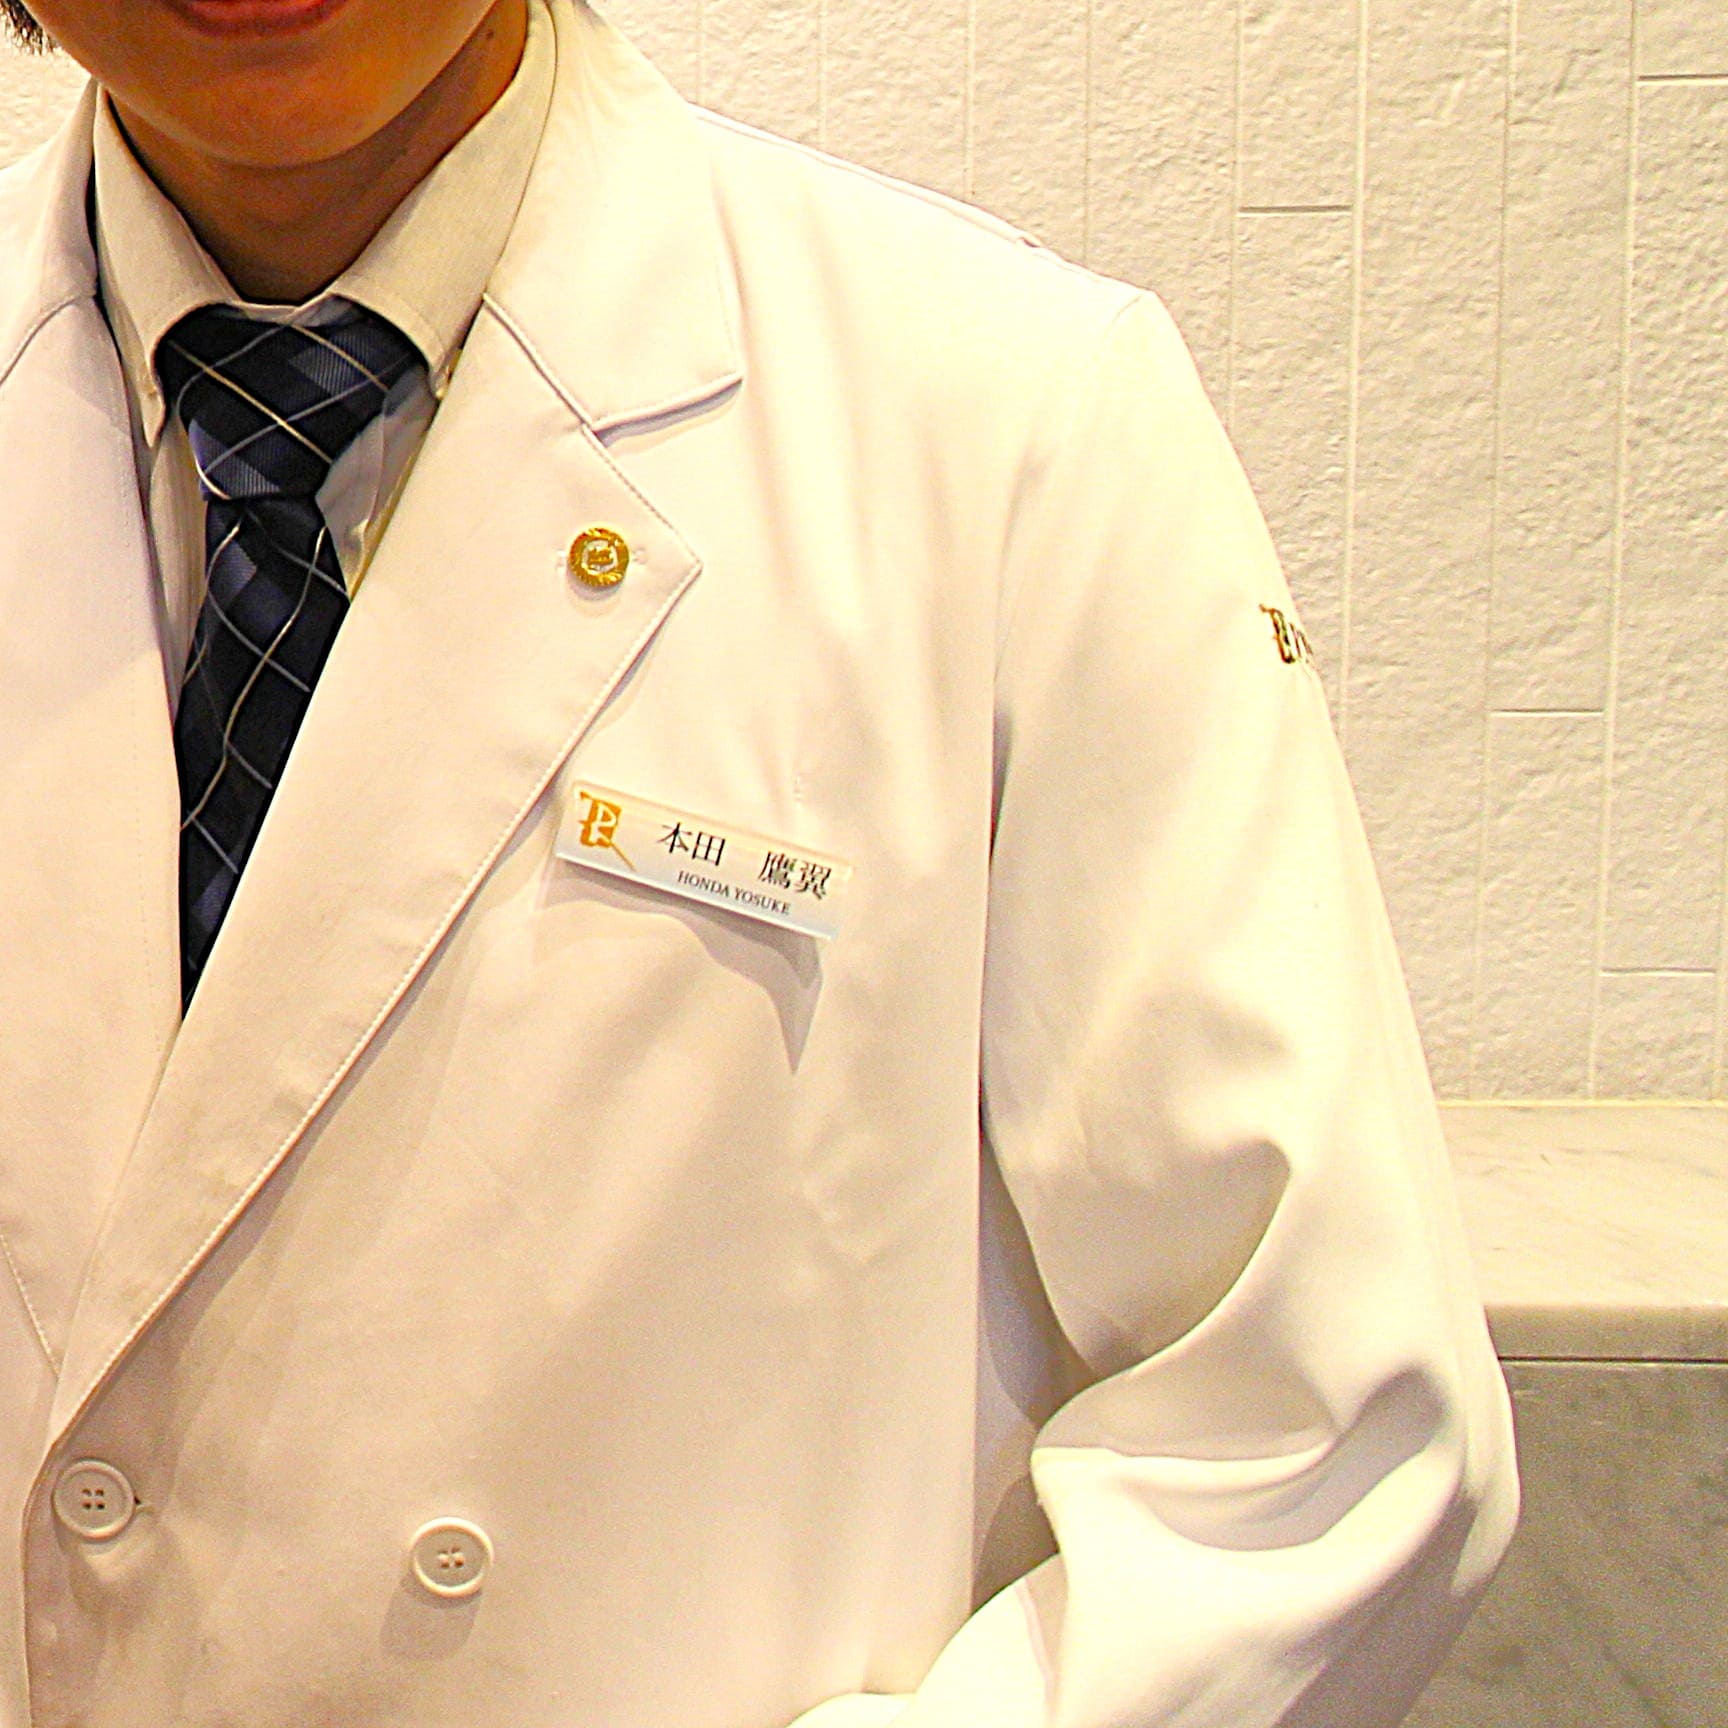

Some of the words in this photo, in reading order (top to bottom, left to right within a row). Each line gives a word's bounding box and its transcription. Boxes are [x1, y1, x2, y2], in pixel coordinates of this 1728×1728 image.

[656, 821, 727, 867] 本田
[677, 871, 730, 896] HONDA
[732, 887, 791, 915] YOSUKE
